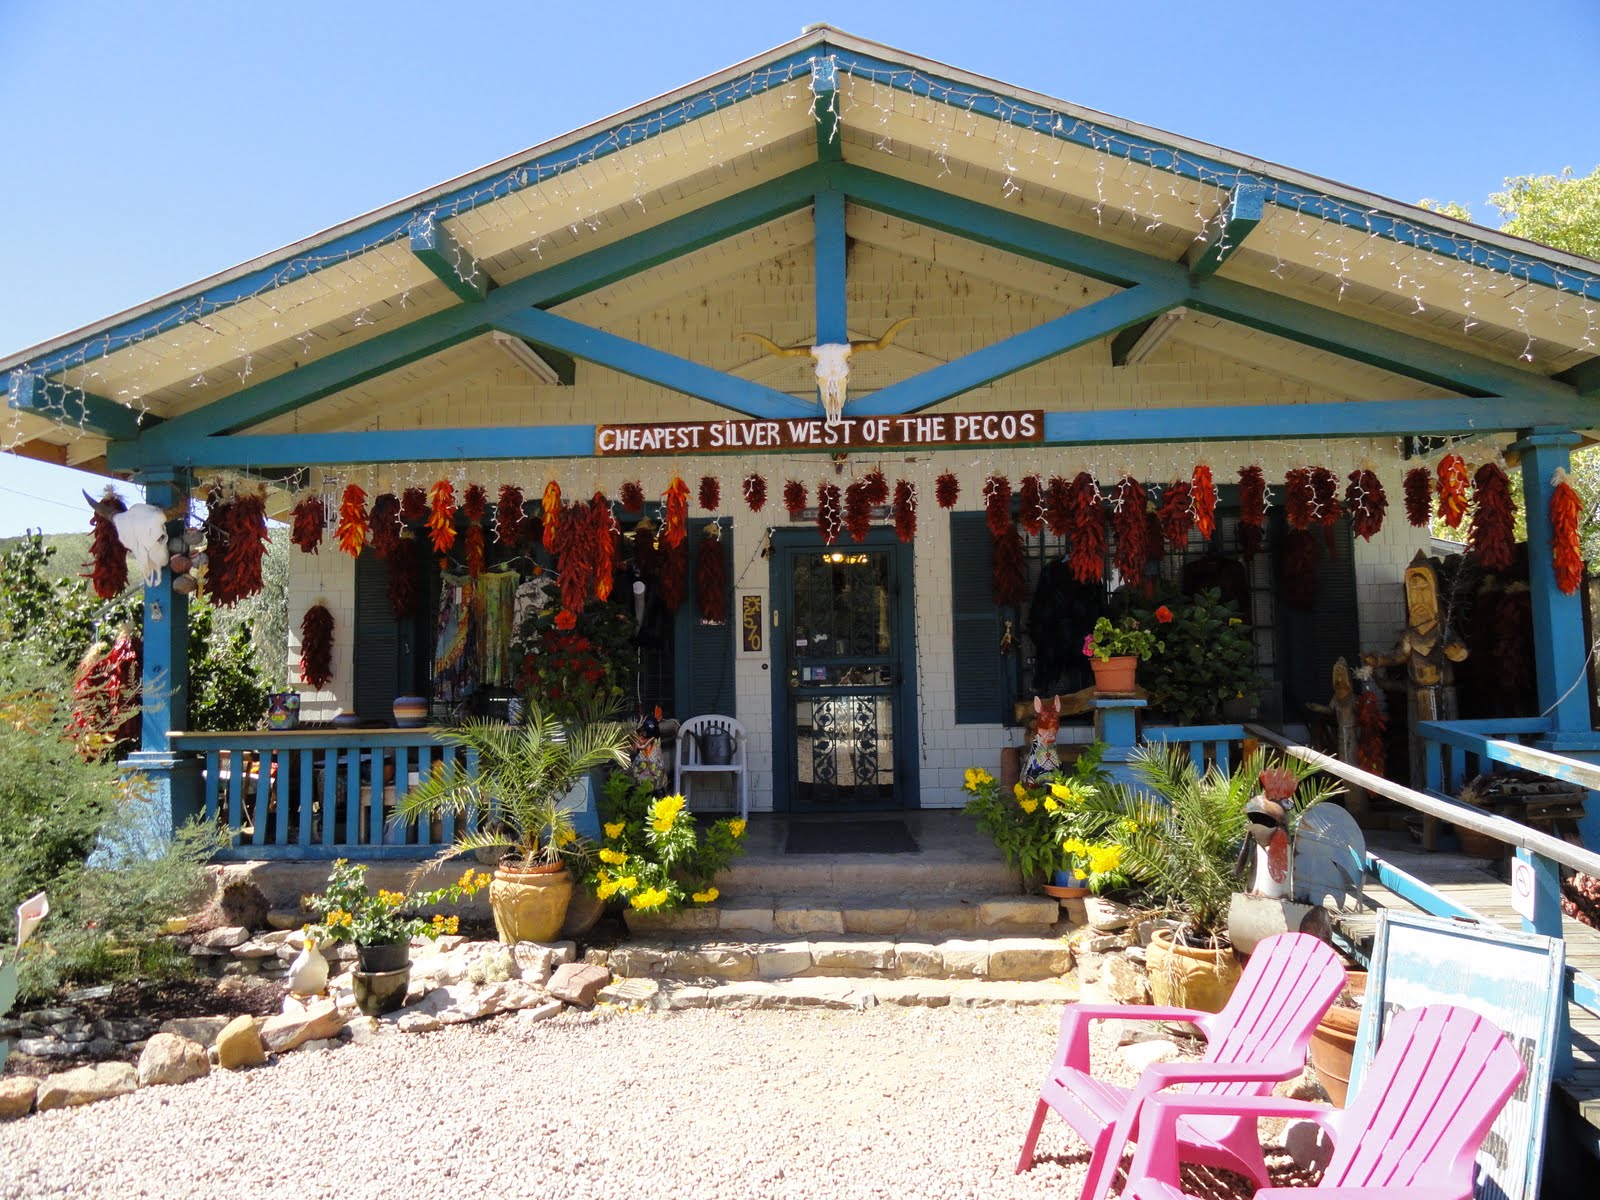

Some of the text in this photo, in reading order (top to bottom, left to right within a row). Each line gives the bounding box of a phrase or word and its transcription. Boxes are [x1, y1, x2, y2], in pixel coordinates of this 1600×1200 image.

[599, 413, 1036, 451] CHEAPEST SILVER WEST OF THE PECOS
[743, 612, 761, 651] 570
